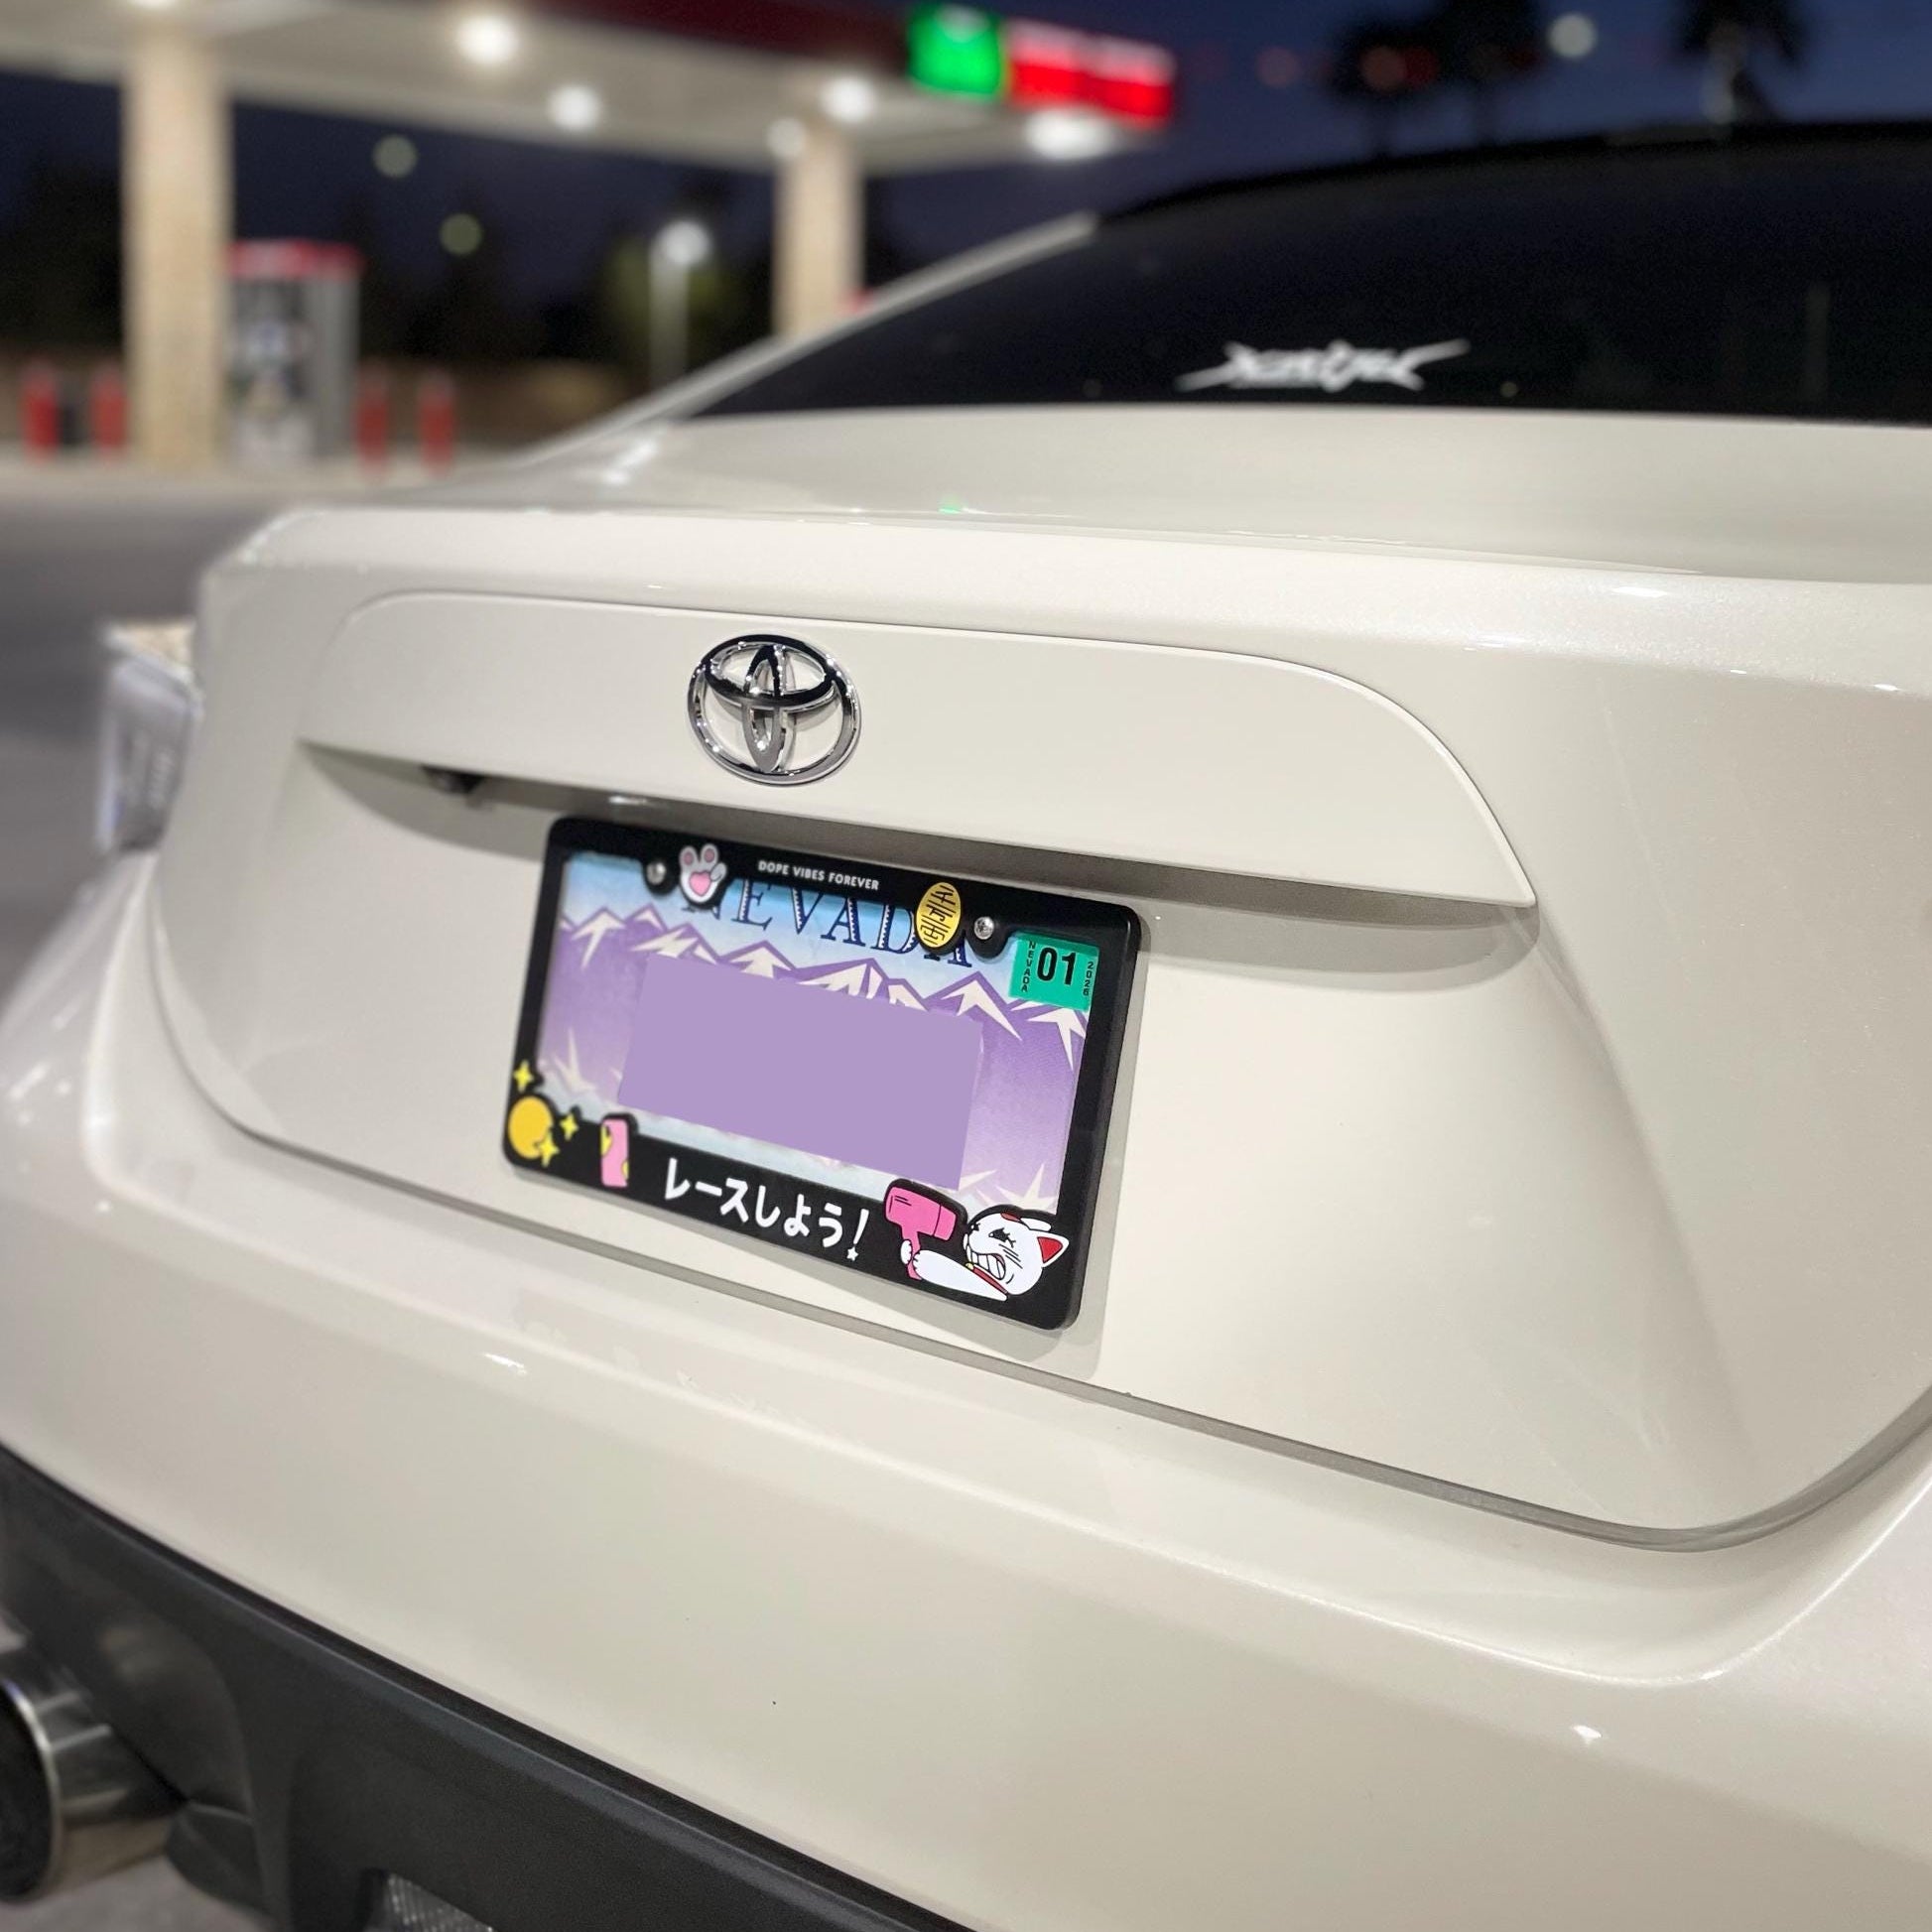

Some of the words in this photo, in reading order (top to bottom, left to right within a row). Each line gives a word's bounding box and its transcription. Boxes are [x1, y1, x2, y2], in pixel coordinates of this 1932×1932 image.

[758, 859, 789, 875] DOPE
[793, 866, 825, 882] VIBES
[828, 872, 879, 890] FOREVER
[682, 879, 972, 968] EVAD
[1021, 941, 1036, 993] NEVADA
[1037, 947, 1077, 985] 01
[1083, 961, 1095, 996] 2026
[665, 1157, 870, 1261] レースしよう!
